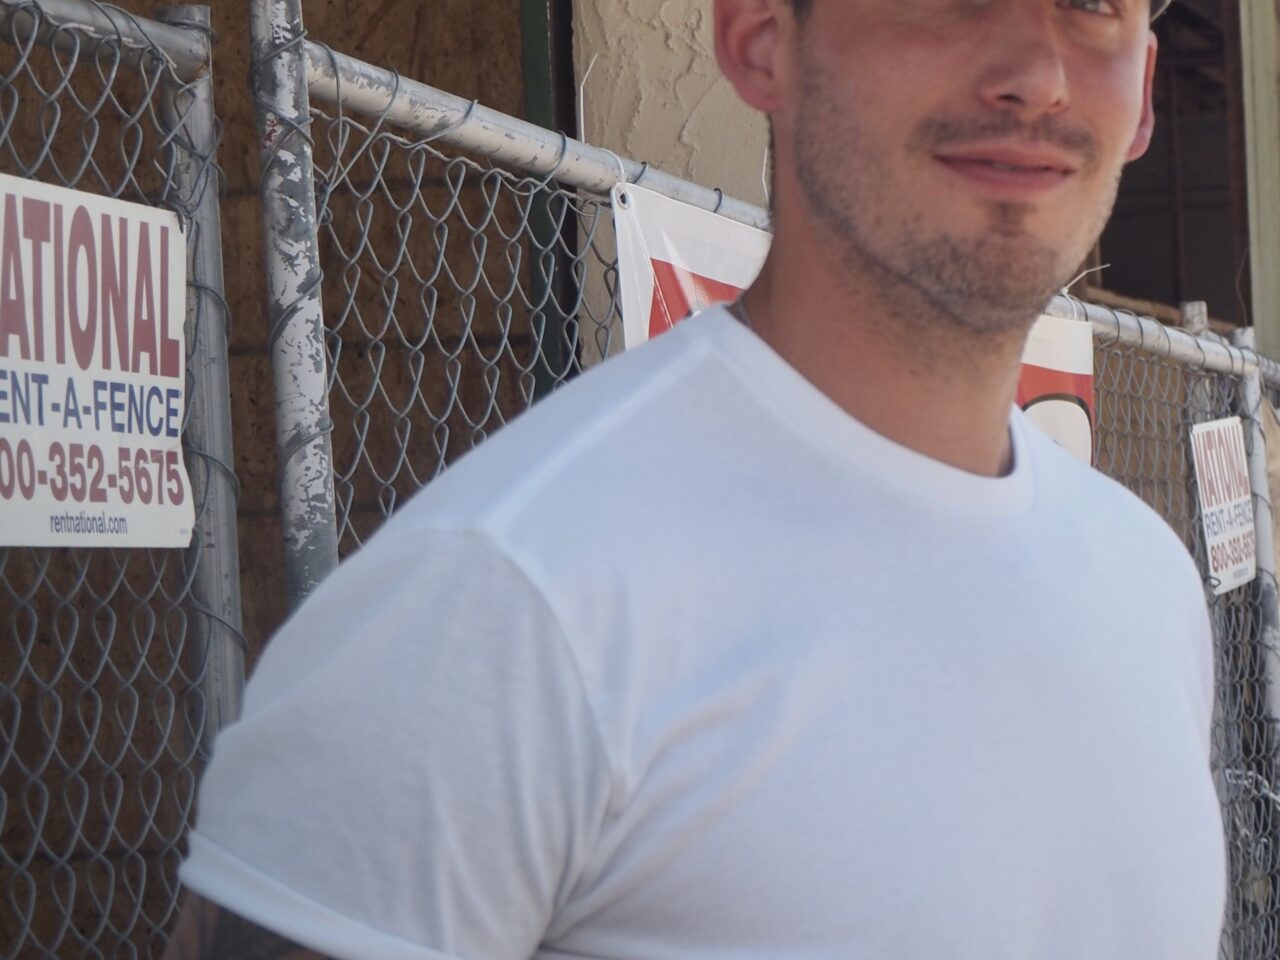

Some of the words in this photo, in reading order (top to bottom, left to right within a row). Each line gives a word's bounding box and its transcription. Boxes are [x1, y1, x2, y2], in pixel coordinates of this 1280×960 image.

[0, 193, 180, 378] ATIONAL
[1193, 423, 1250, 509] NATIONAL
[50, 510, 128, 536] rentnational.com
